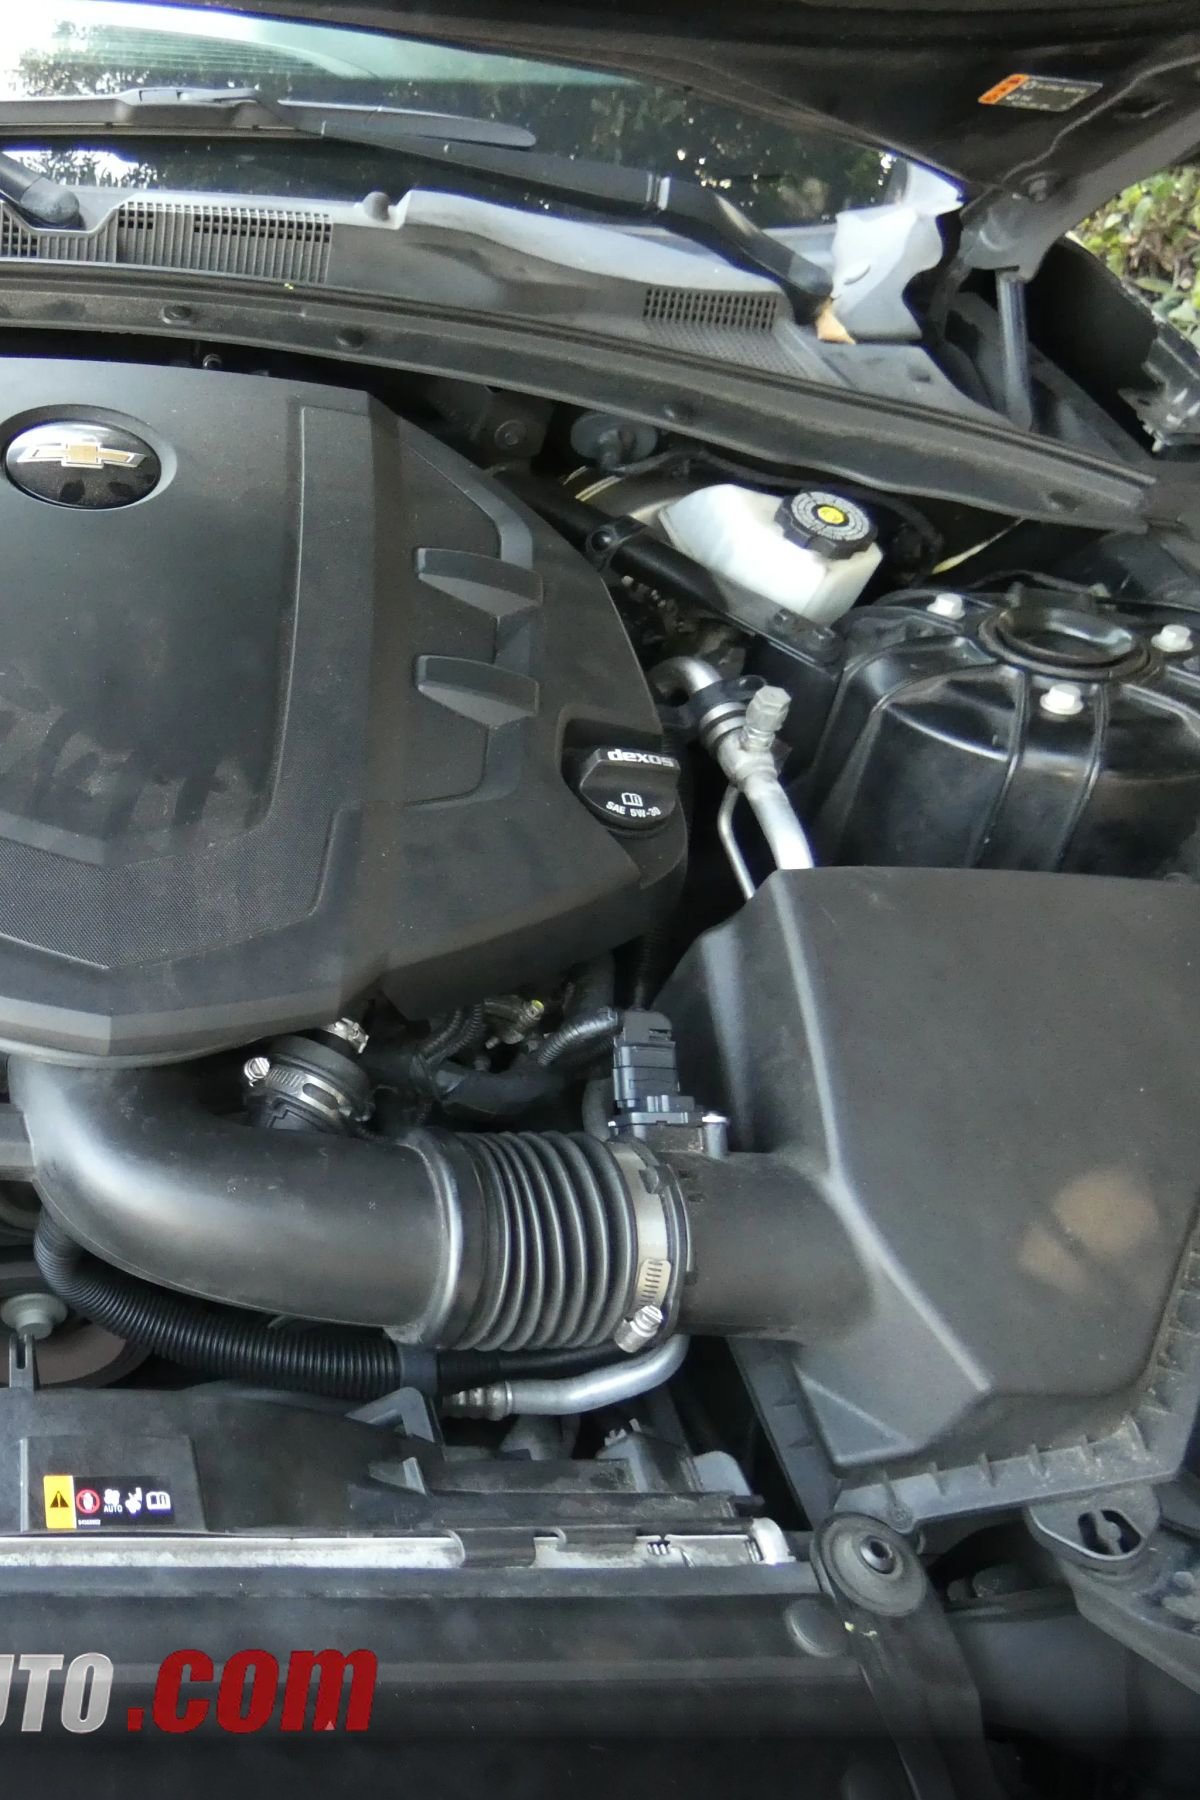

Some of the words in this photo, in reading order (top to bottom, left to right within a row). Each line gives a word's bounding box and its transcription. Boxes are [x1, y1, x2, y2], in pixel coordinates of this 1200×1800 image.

[607, 748, 675, 768] dexos
[606, 801, 626, 815] SAE
[629, 806, 661, 818] 5W-30
[103, 1504, 123, 1513] AUTO
